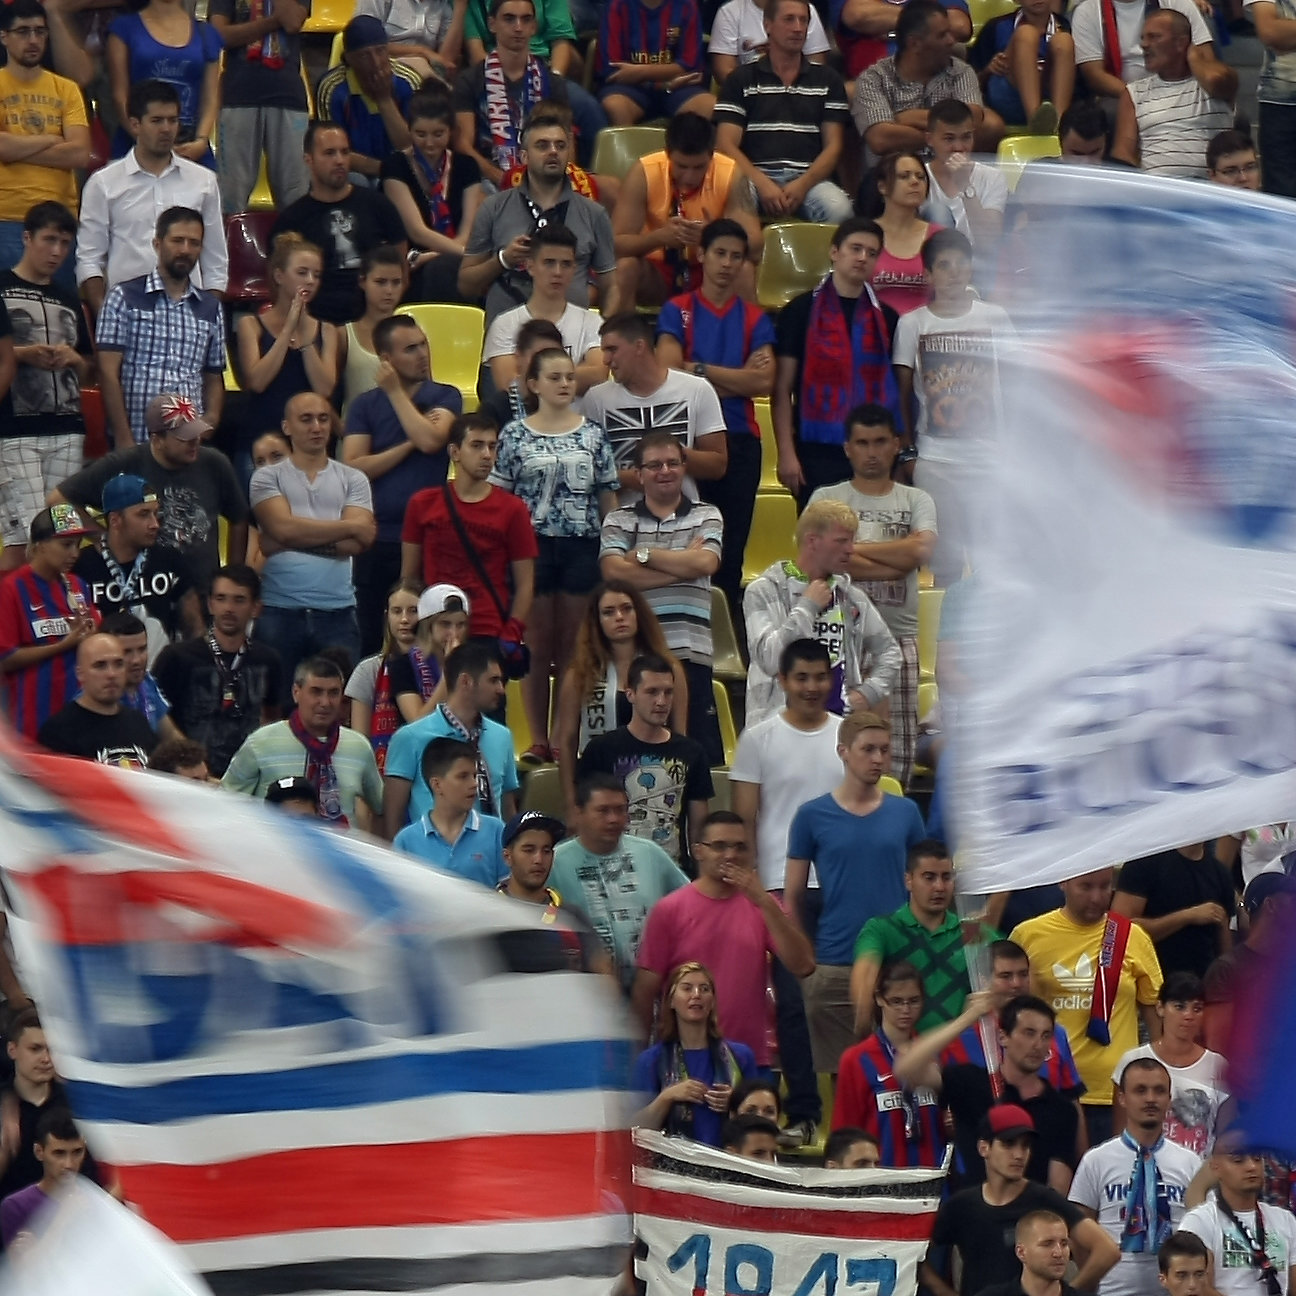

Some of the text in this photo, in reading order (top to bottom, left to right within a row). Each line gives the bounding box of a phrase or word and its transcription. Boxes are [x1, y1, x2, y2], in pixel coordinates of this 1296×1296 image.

[91, 572, 180, 604] FOLO
[1052, 995, 1093, 1011] adid
[1105, 1184, 1186, 1203] VICRY
